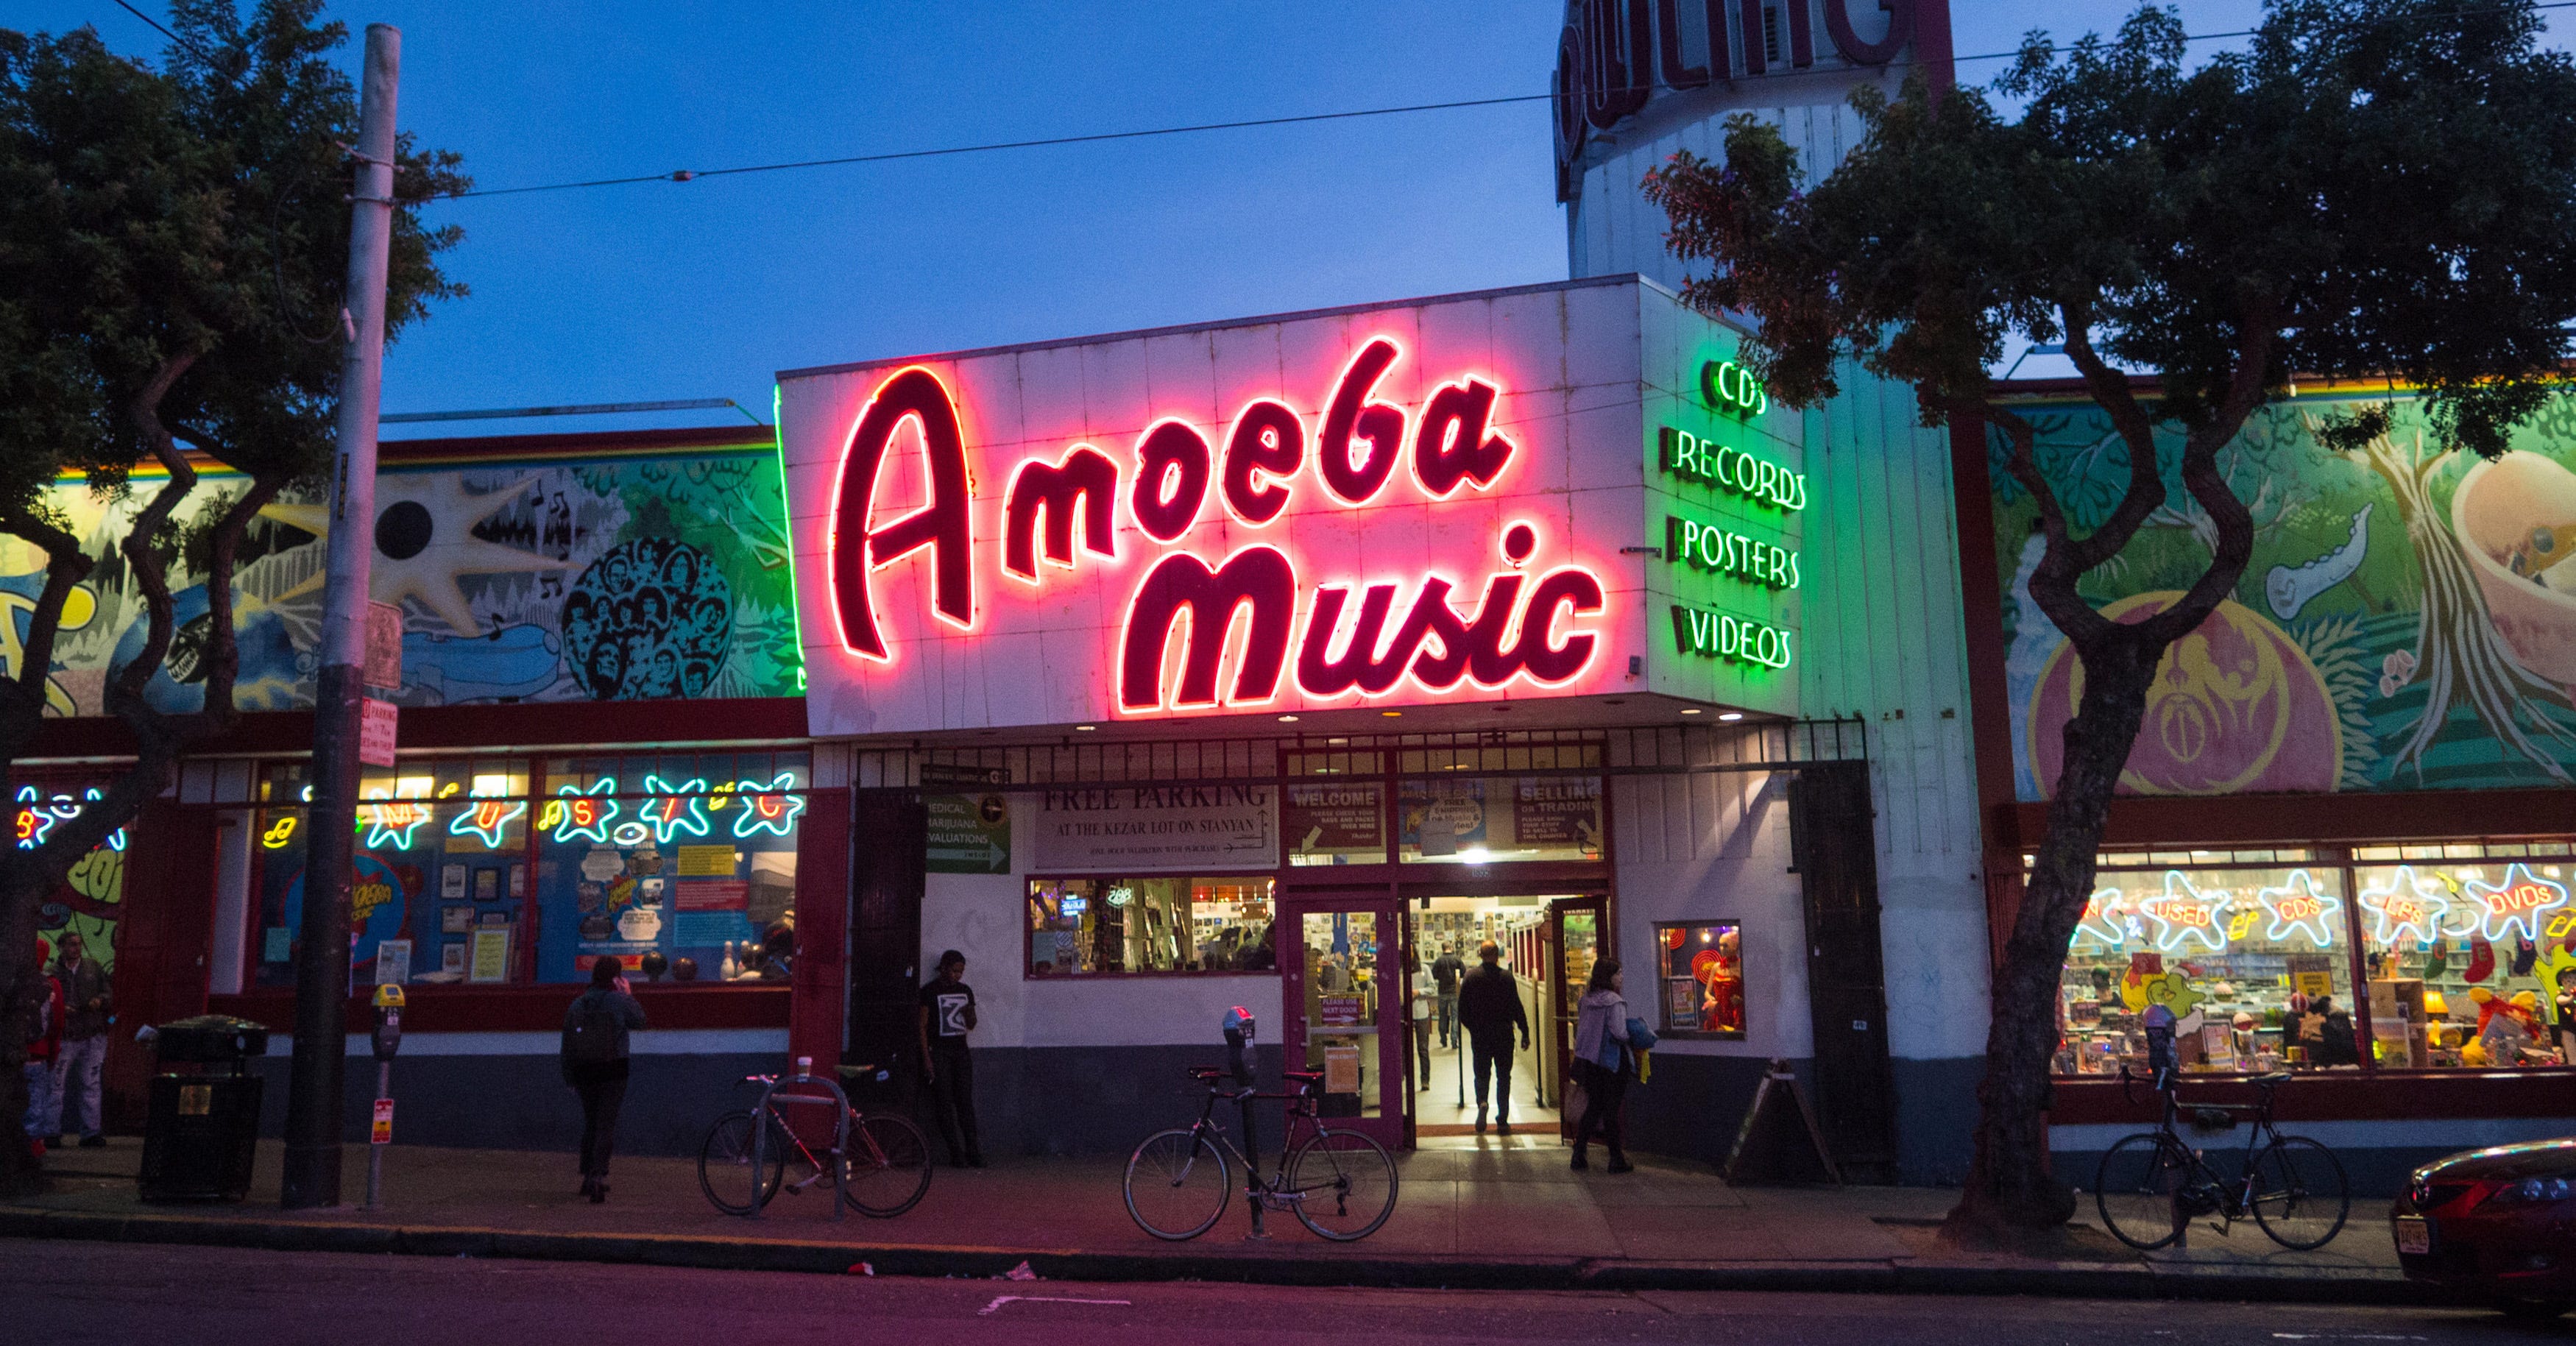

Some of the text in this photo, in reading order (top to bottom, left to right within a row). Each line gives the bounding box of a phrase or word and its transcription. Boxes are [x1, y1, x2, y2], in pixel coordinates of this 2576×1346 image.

[1673, 430, 1806, 510] RECORDS
[829, 336, 1517, 663] Amoeba
[1684, 520, 1800, 589] POSTERS
[1117, 520, 1605, 713] Music
[1689, 608, 1791, 669] VIDEOS
[371, 706, 396, 722] PARKING
[1044, 784, 1267, 811] FREE PARKING
[1294, 791, 1375, 807] WELCOME
[927, 832, 988, 844] VALUATIONS
[1058, 818, 1255, 837] AT THE KEZAR LOT ON STANYAN
[2156, 902, 2210, 928] USED
